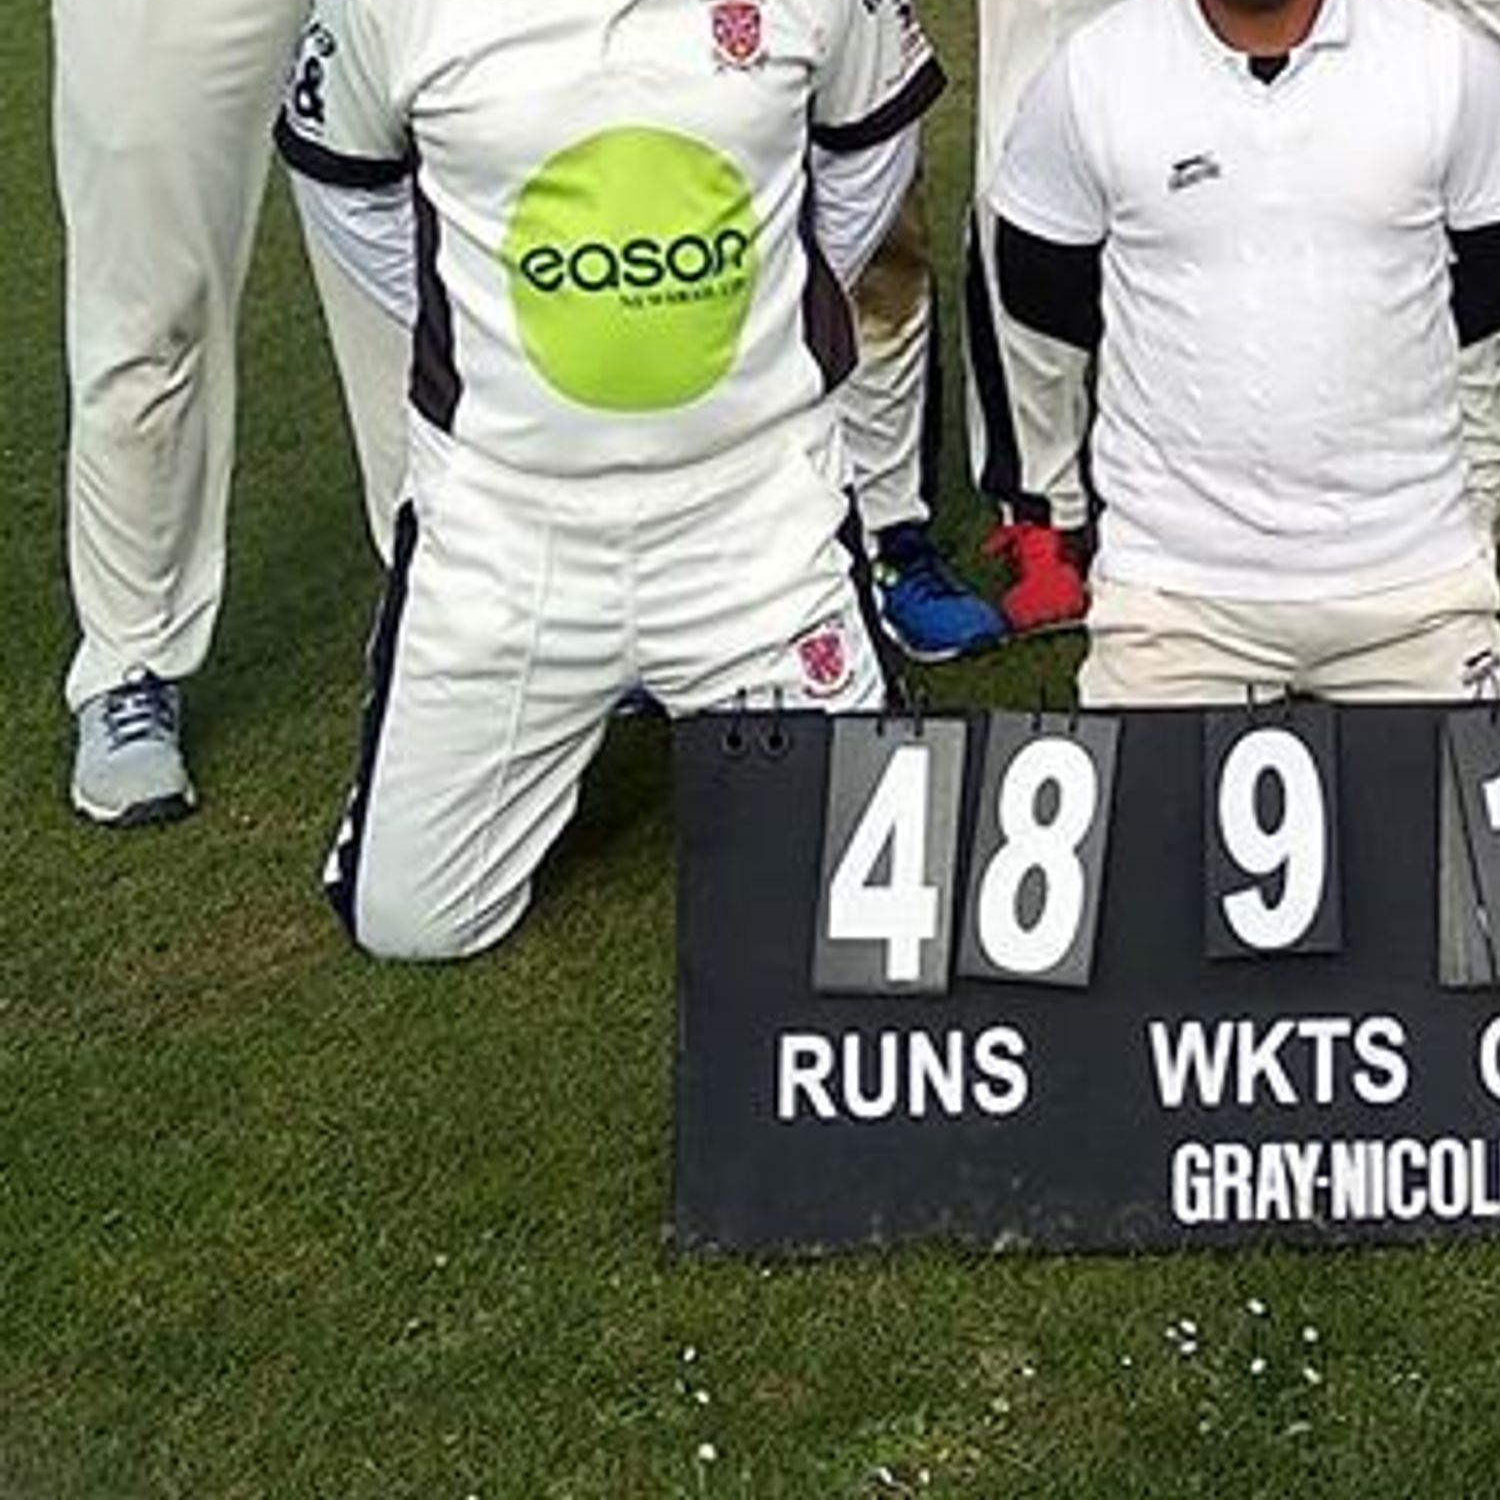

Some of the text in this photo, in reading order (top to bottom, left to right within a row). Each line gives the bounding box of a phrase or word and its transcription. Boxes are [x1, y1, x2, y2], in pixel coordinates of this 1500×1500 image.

[519, 228, 748, 292] eason
[1218, 728, 1326, 951] 9
[776, 1026, 1031, 1120] RUNS
[1149, 1016, 1408, 1108] WKTS
